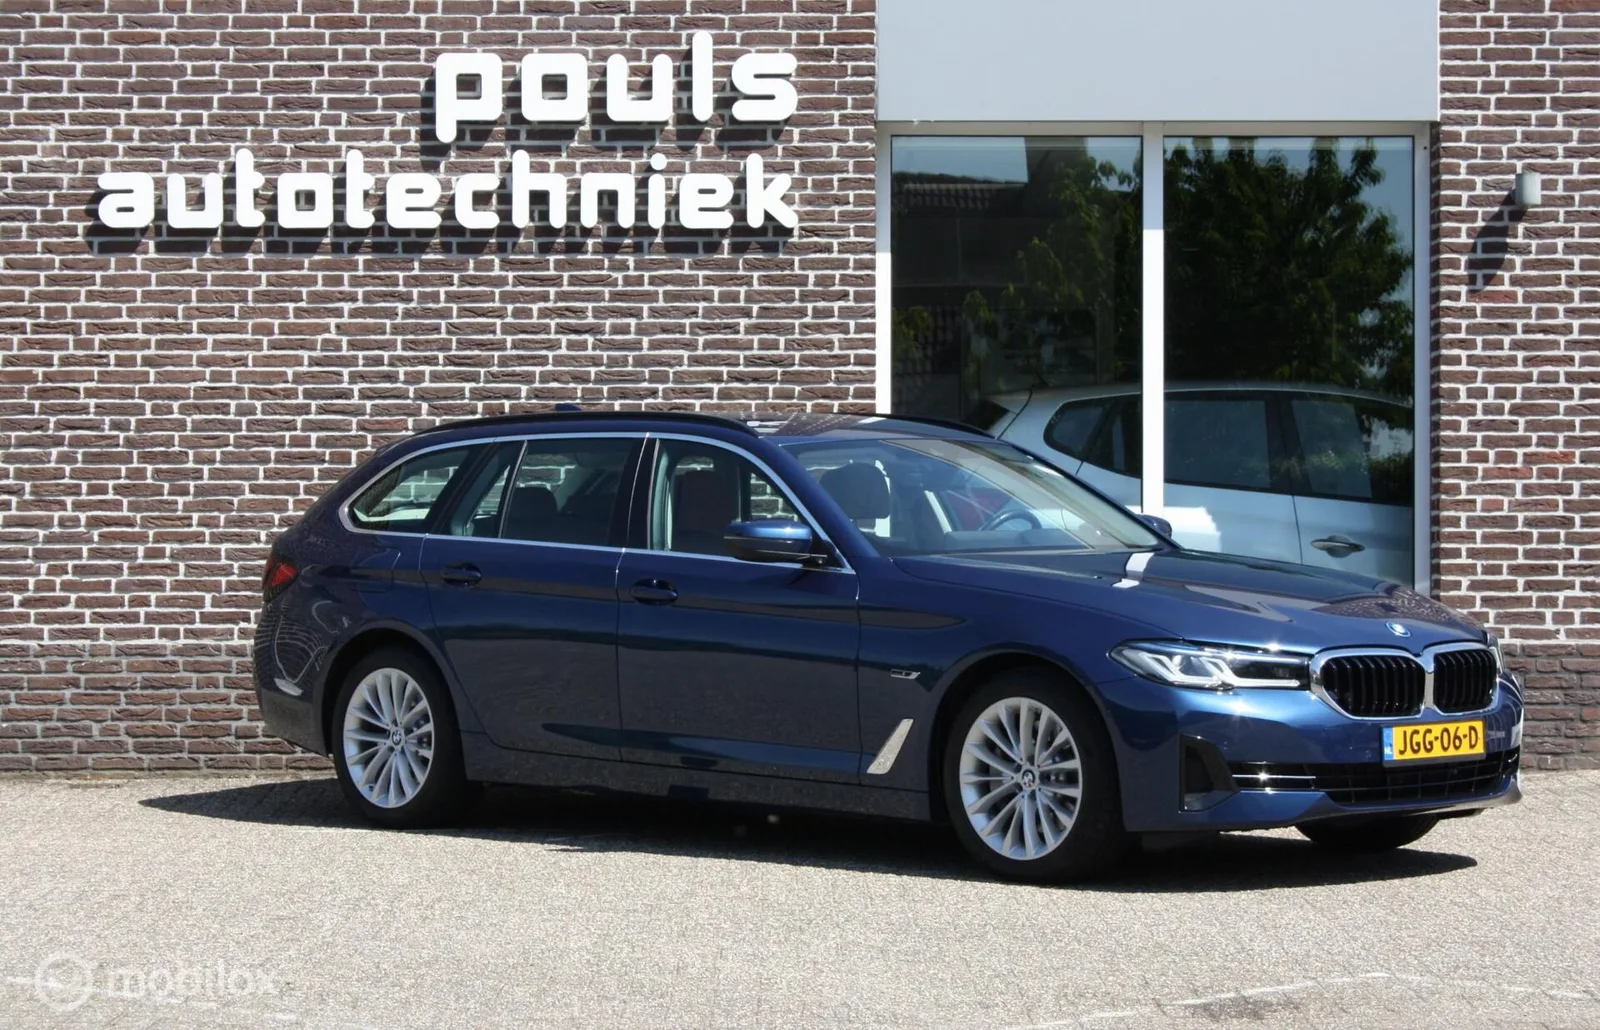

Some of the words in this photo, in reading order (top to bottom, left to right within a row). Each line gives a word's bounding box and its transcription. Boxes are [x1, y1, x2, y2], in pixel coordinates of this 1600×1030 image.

[435, 31, 798, 143] pouls
[97, 148, 800, 229] autotechniek
[1398, 725, 1479, 755] JGG-06-D
